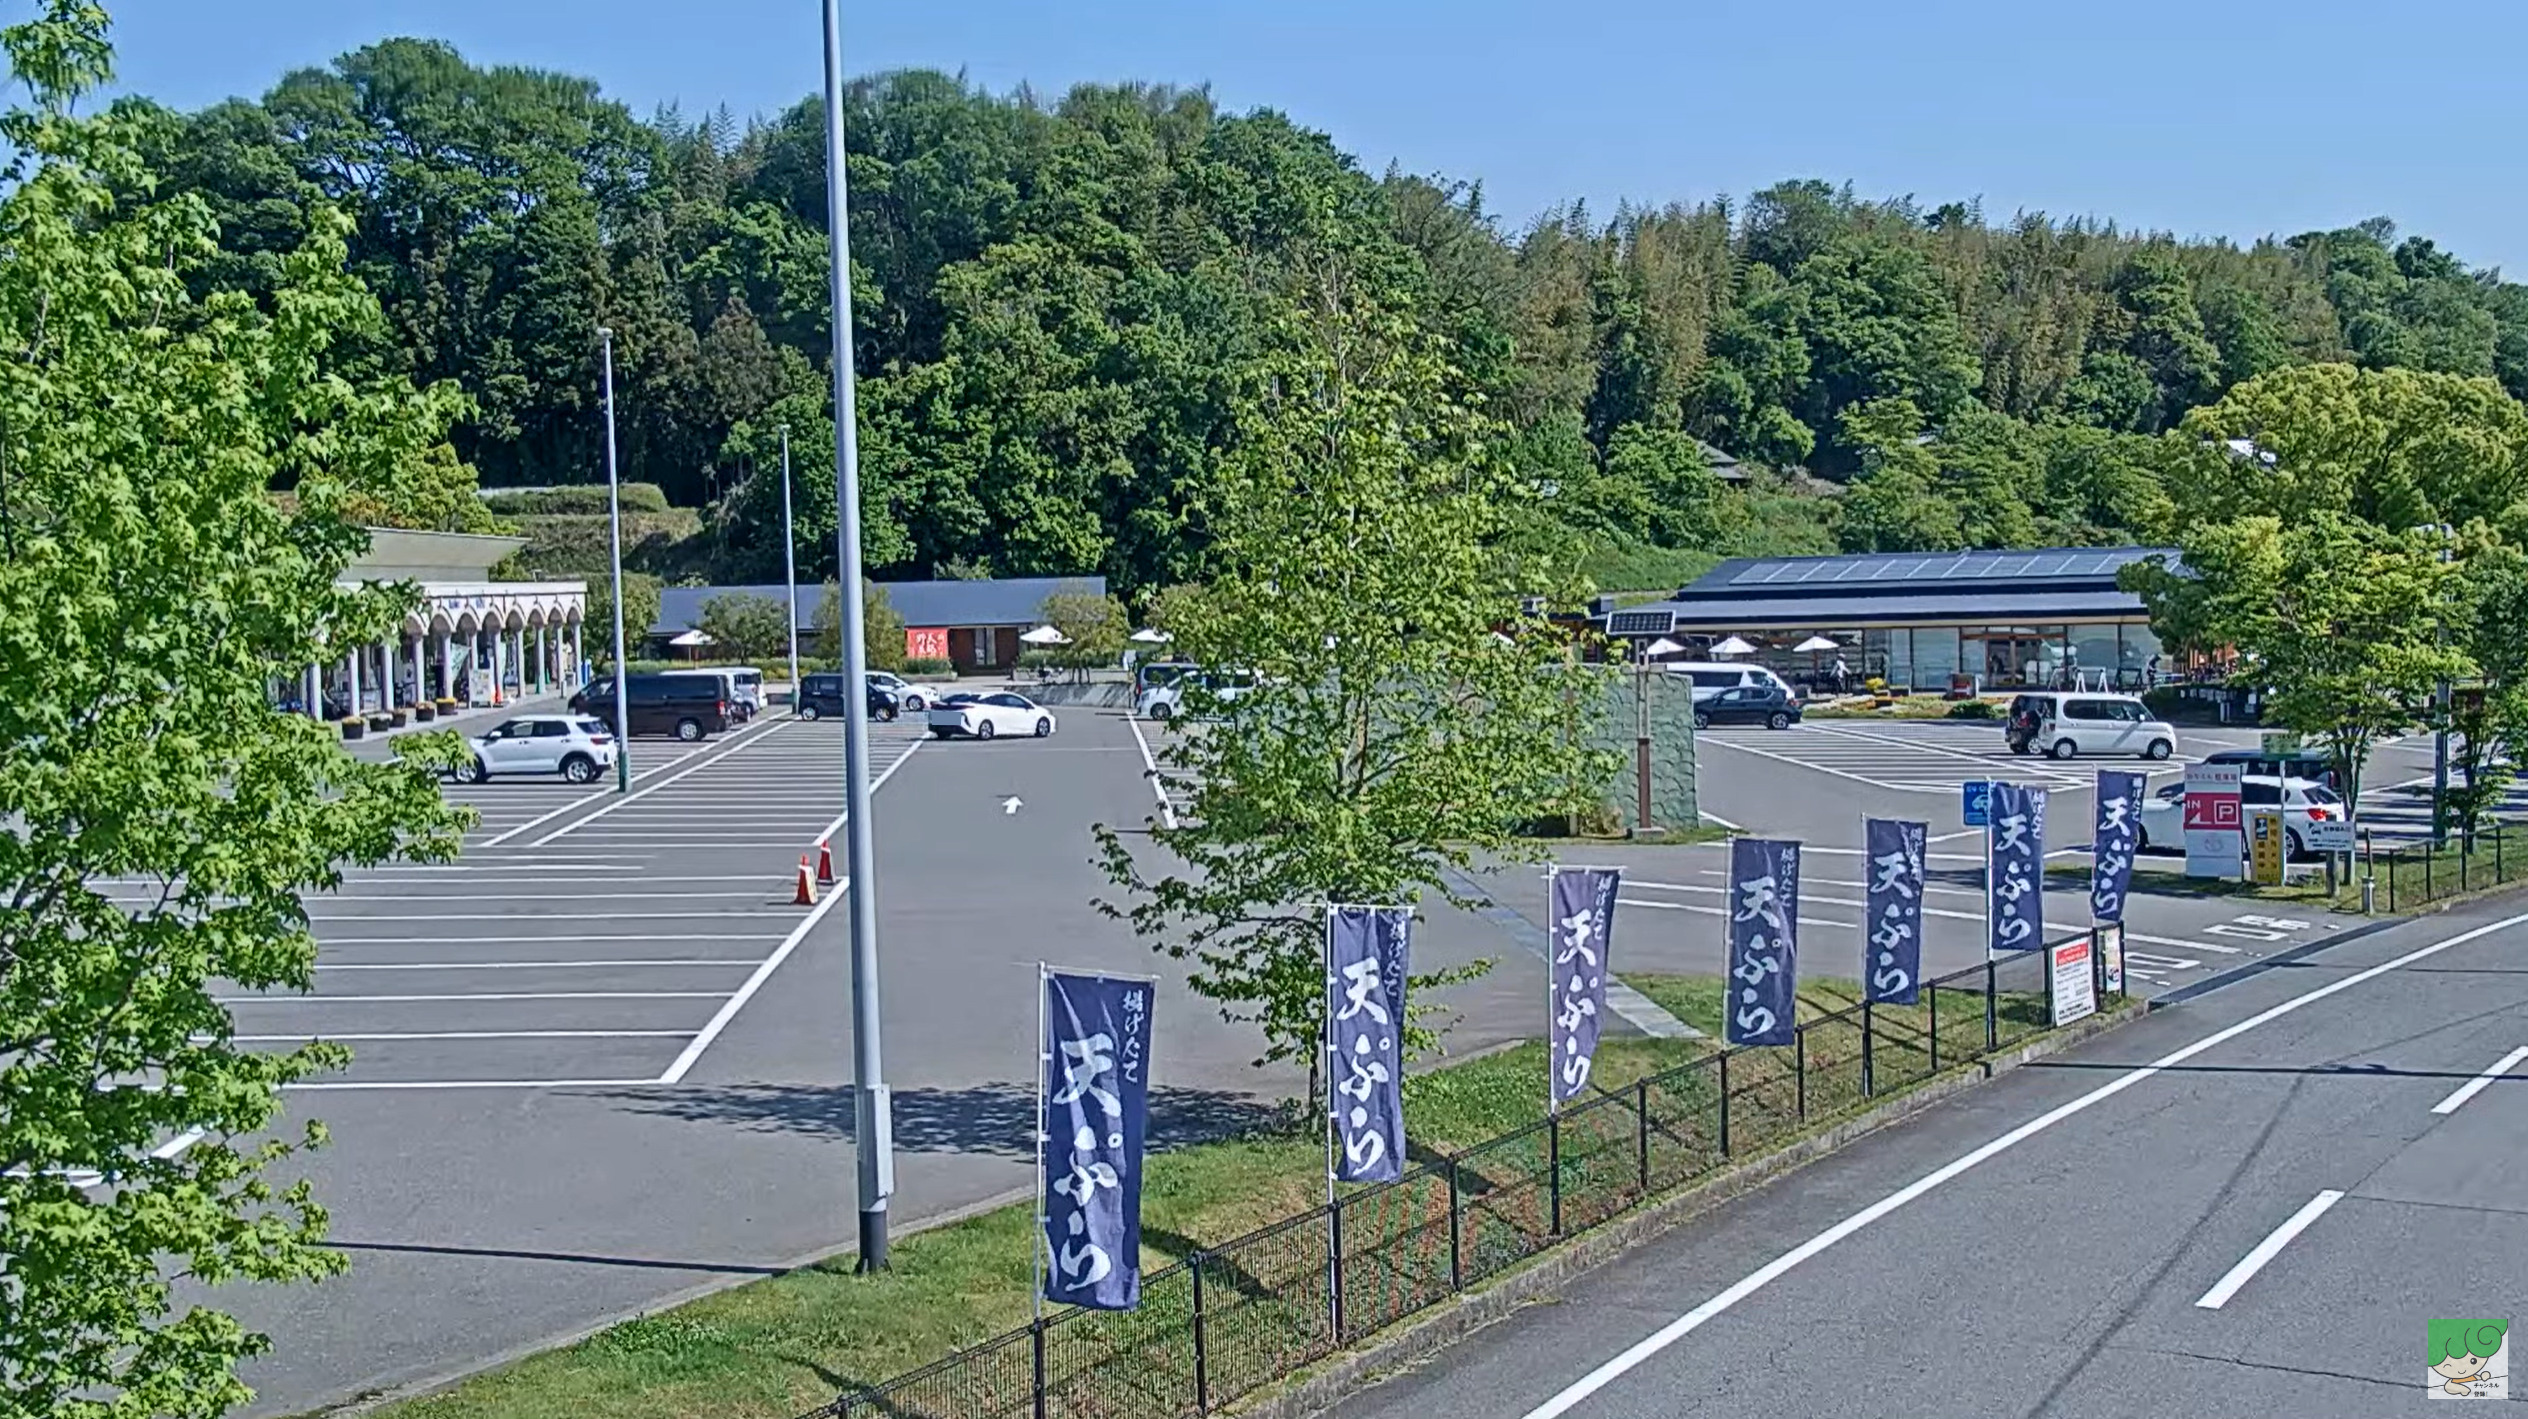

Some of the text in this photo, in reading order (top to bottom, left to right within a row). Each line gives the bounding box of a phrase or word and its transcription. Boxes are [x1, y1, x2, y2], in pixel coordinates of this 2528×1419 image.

[2094, 796, 2131, 915] 天ぷら
[2186, 799, 2201, 809] IN
[2218, 805, 2234, 820] P
[1870, 851, 1913, 997] 天ぷら
[1994, 813, 2031, 945] 天ぷら
[1556, 908, 1596, 1097] 天ぷら
[1733, 876, 1780, 1039] 天ぷら
[1123, 989, 1145, 1084] 揚げたて
[1336, 956, 1390, 1176] 天ぷら
[1052, 1032, 1123, 1291] 天ぷら
